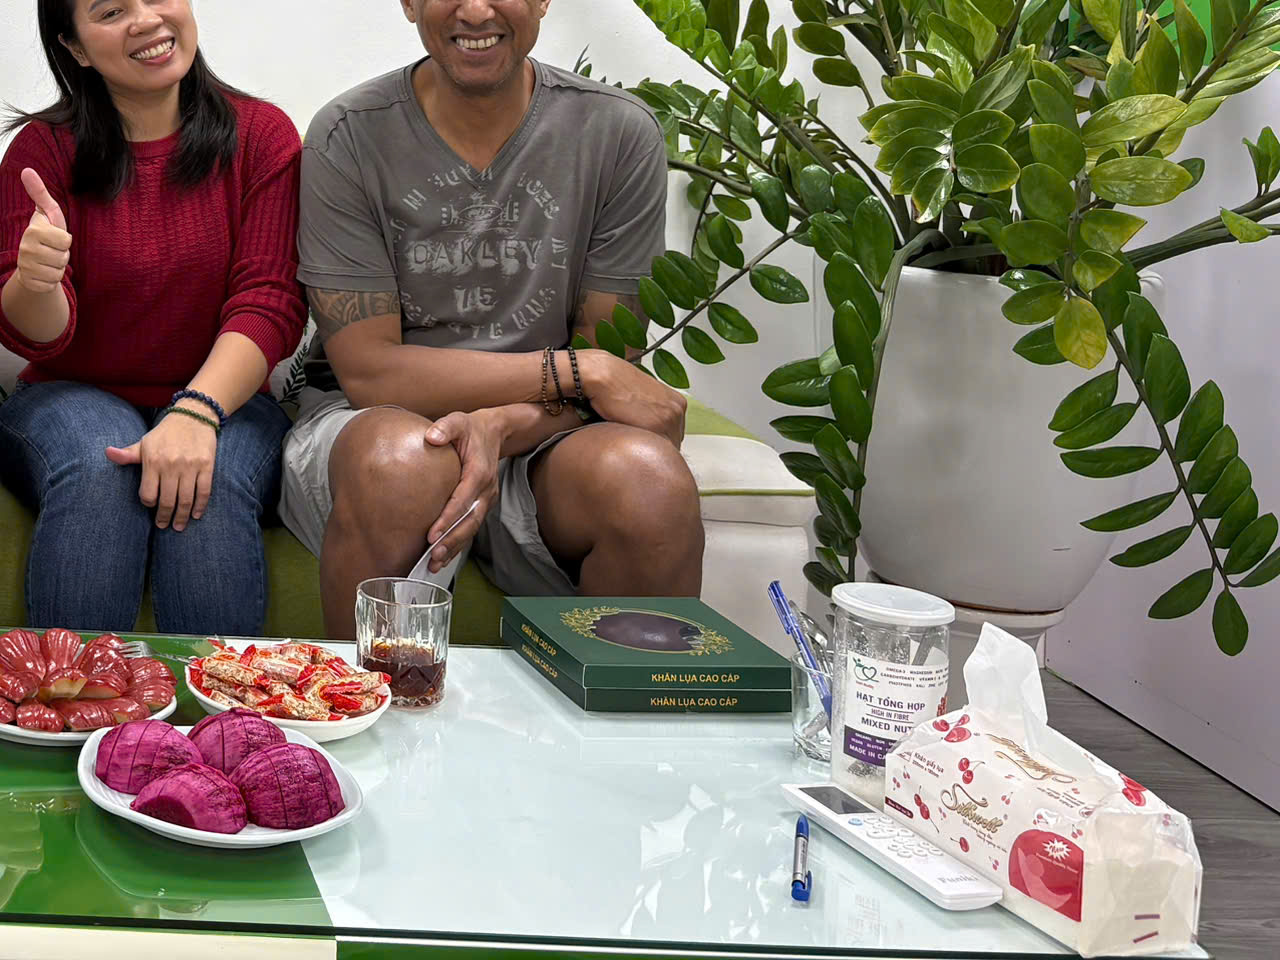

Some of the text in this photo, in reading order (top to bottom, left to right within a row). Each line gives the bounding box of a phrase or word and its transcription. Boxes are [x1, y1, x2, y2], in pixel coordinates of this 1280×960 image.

[408, 239, 542, 274] OAKLEY
[699, 674, 719, 683] CAO
[697, 698, 718, 706] CAO
[871, 708, 885, 717] HIGH
[893, 713, 910, 721] FIBRE
[861, 717, 891, 731] MIXED
[849, 744, 867, 755] MADE
